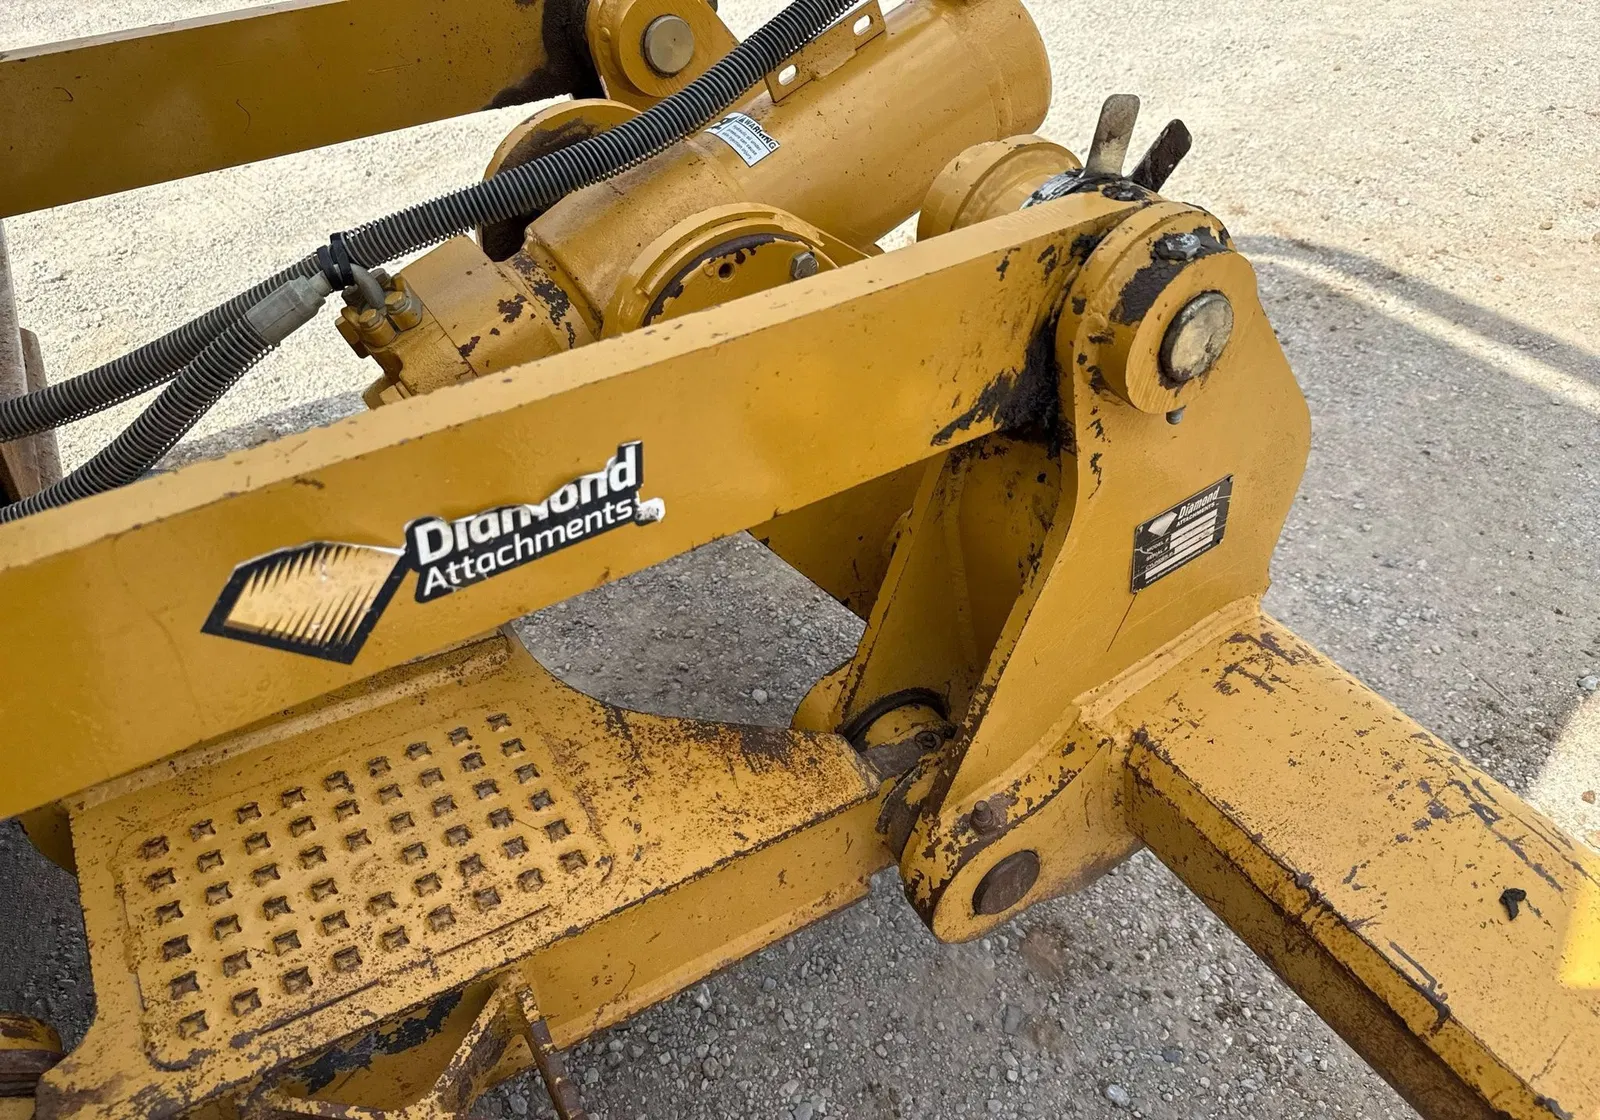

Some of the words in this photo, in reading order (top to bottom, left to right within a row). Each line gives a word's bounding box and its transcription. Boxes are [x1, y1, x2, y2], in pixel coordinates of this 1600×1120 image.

[744, 118, 777, 150] WARNING
[414, 445, 637, 566] Diamond
[1176, 501, 1215, 528] ATTACHMENTS
[1178, 486, 1220, 520] Diamond
[423, 498, 633, 597] Attachments
